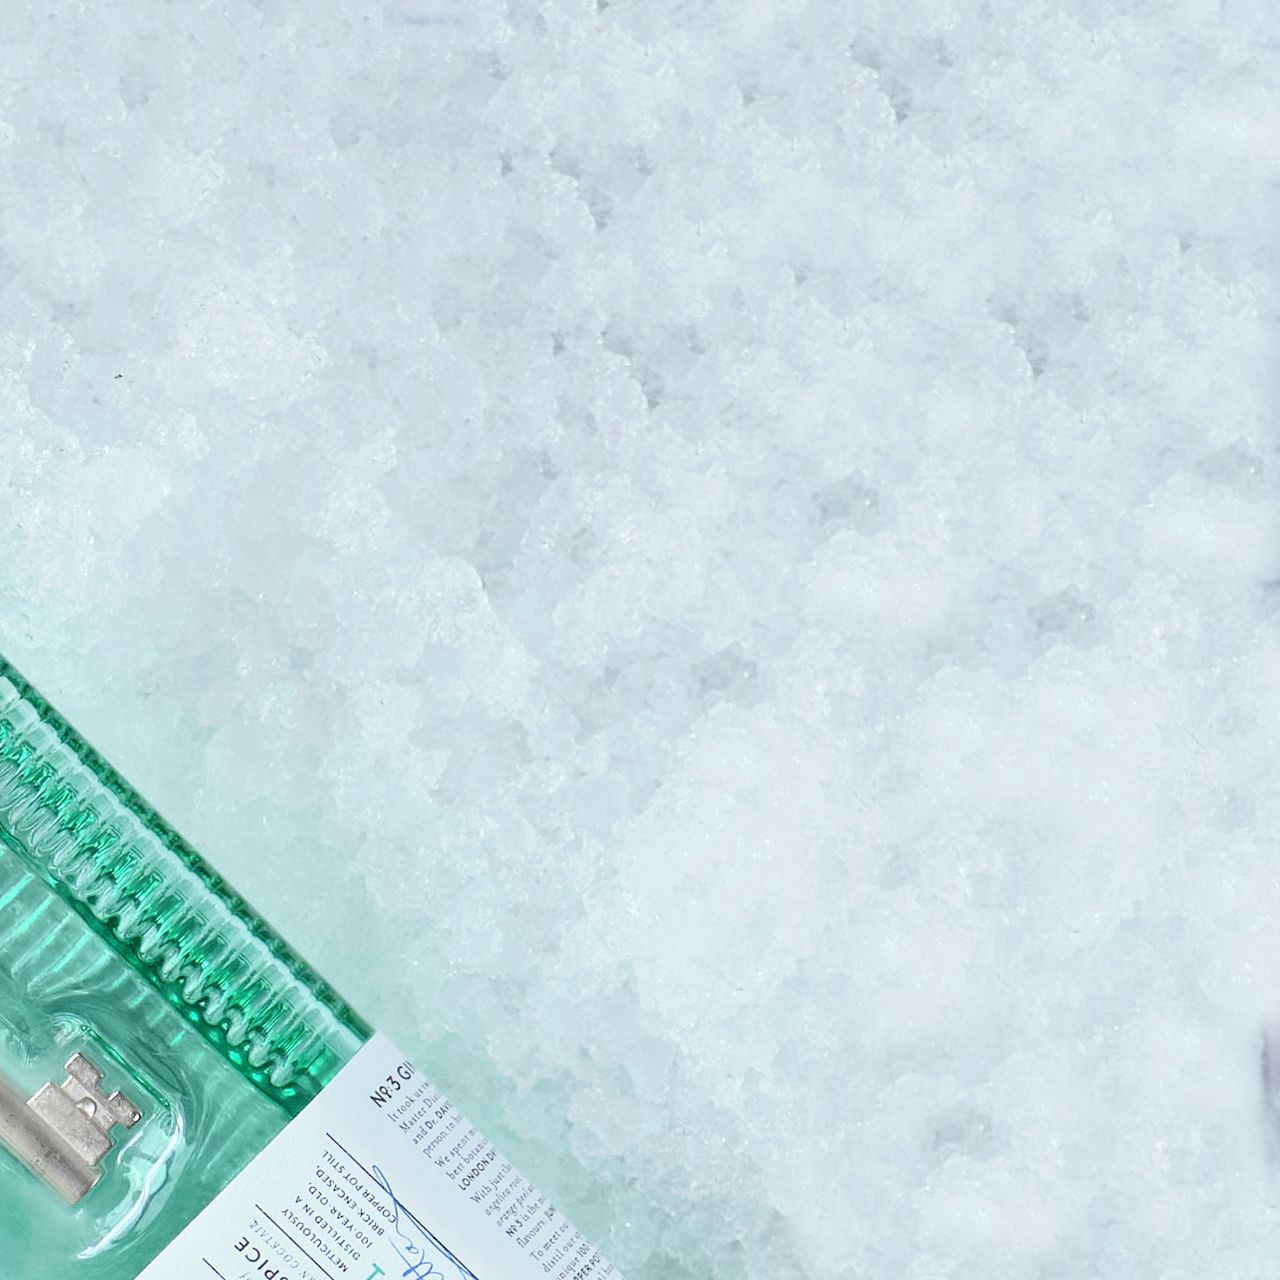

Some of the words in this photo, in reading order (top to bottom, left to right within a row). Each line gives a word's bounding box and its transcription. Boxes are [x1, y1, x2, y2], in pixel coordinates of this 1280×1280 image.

[386, 1113, 400, 1123] It
[396, 1095, 416, 1115] took
[413, 1088, 424, 1098] us
[398, 1106, 427, 1134] Master
[412, 1125, 429, 1145] and
[424, 1119, 439, 1130] Dr.
[422, 1130, 448, 1159] person
[445, 1122, 456, 1132] to
[322, 1149, 346, 1174] STILL
[433, 1155, 451, 1168] We
[449, 1134, 471, 1158] spent
[342, 1172, 364, 1192] POT
[444, 1162, 465, 1180] best
[457, 1157, 490, 1191] LONDON
[295, 1195, 303, 1204] A
[469, 1184, 493, 1204] With
[488, 1171, 506, 1192] just
[484, 1187, 512, 1217] angelica
[302, 1203, 315, 1216] IN
[361, 1188, 399, 1224] COPPER
[496, 1203, 518, 1228] orange
[519, 1214, 530, 1222] is
[526, 1202, 541, 1216] the
[249, 1218, 300, 1269] COCKTAIL
[281, 1208, 349, 1273] METICULOUSLY
[314, 1215, 361, 1261] DISTILLED
[528, 1249, 545, 1262] To
[542, 1231, 561, 1252] meet
[541, 1248, 565, 1273] distil
[562, 1237, 576, 1253] our
